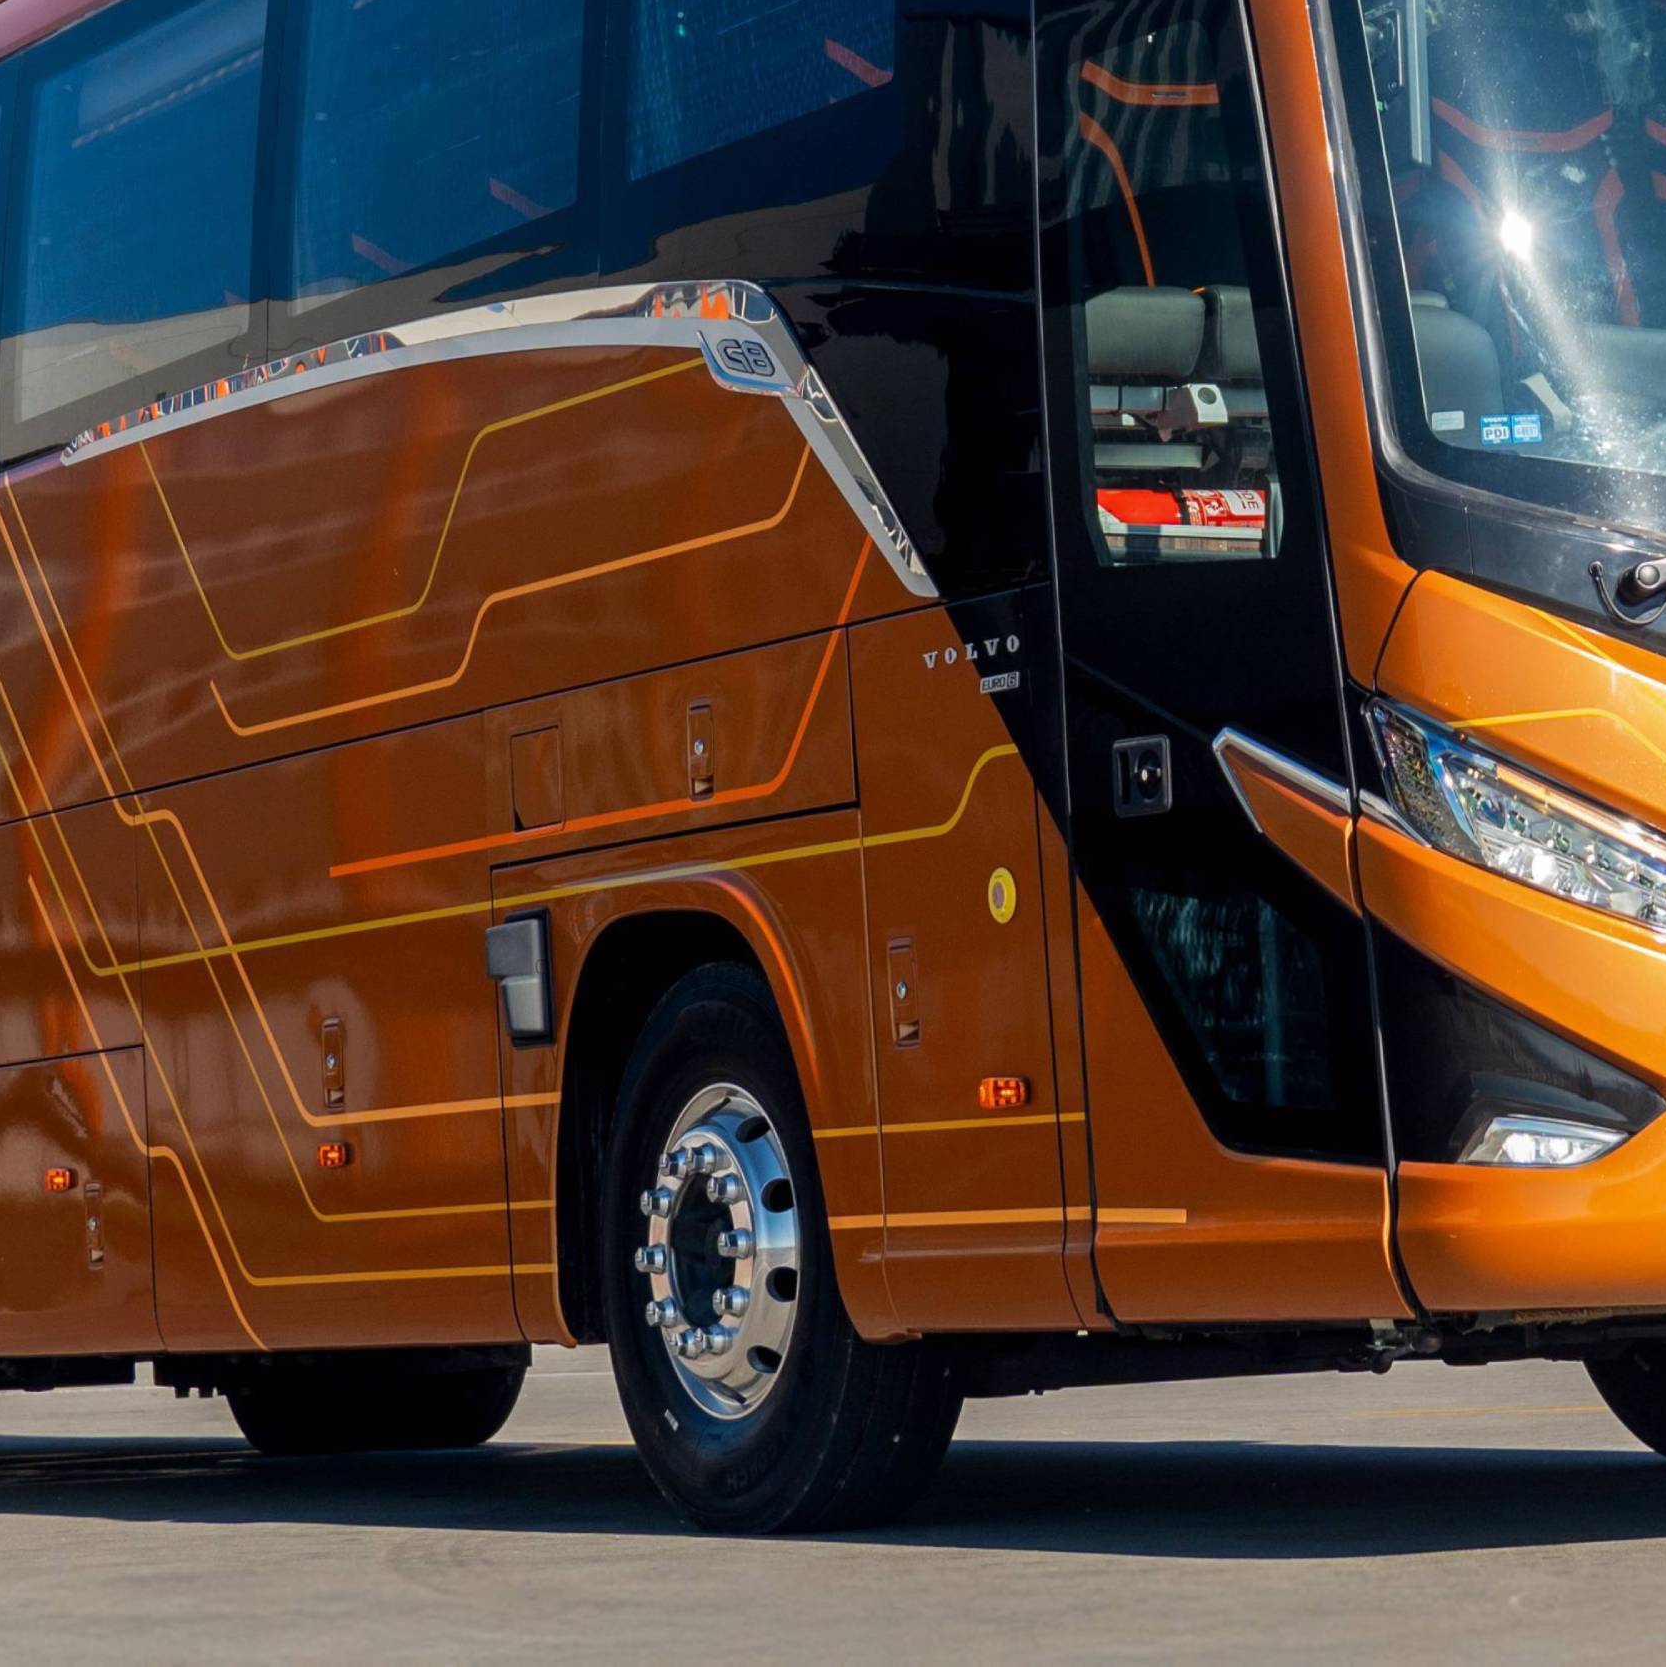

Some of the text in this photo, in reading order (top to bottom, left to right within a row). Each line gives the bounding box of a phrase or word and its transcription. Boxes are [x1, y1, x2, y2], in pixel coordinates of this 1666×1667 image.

[717, 338, 775, 377] G8
[1485, 428, 1507, 438] PDI
[922, 634, 1020, 669] VOLVO
